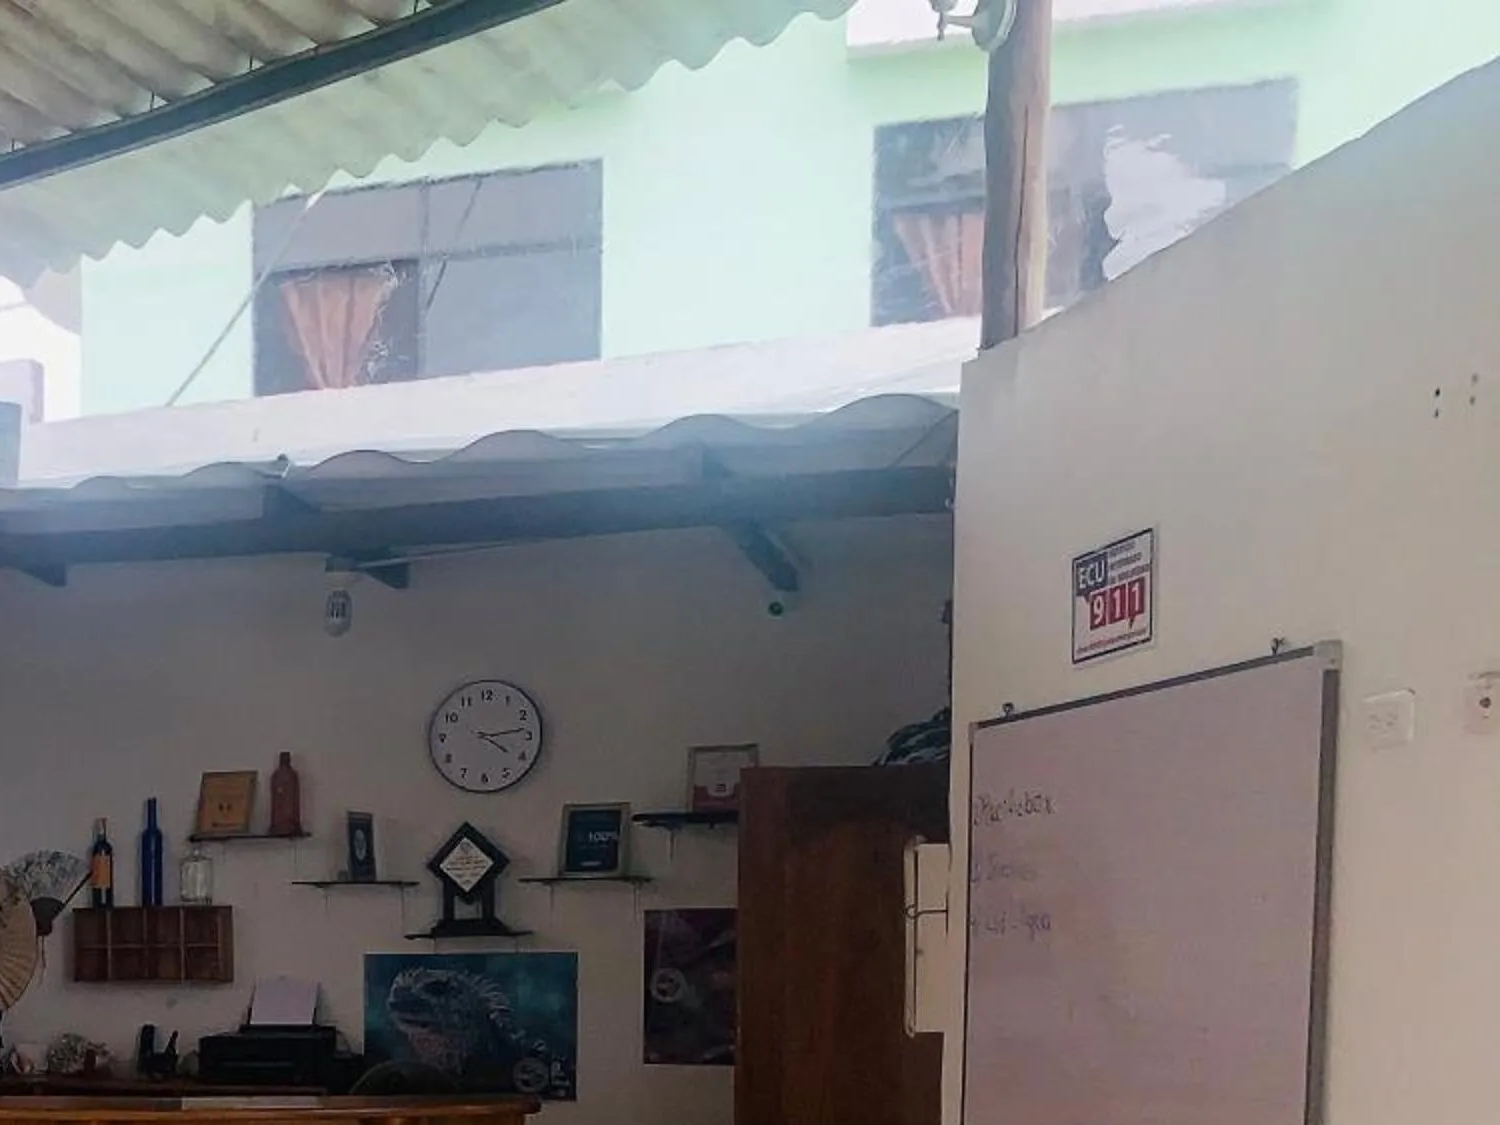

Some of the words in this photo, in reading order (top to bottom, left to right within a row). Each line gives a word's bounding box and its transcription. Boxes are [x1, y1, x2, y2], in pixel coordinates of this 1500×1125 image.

[1078, 559, 1105, 589] ECU
[1093, 584, 1140, 626] 911
[481, 689, 493, 702] 12
[461, 697, 472, 708] 11
[445, 712, 459, 723] 10
[519, 709, 527, 721] 2
[460, 767, 468, 779] 7
